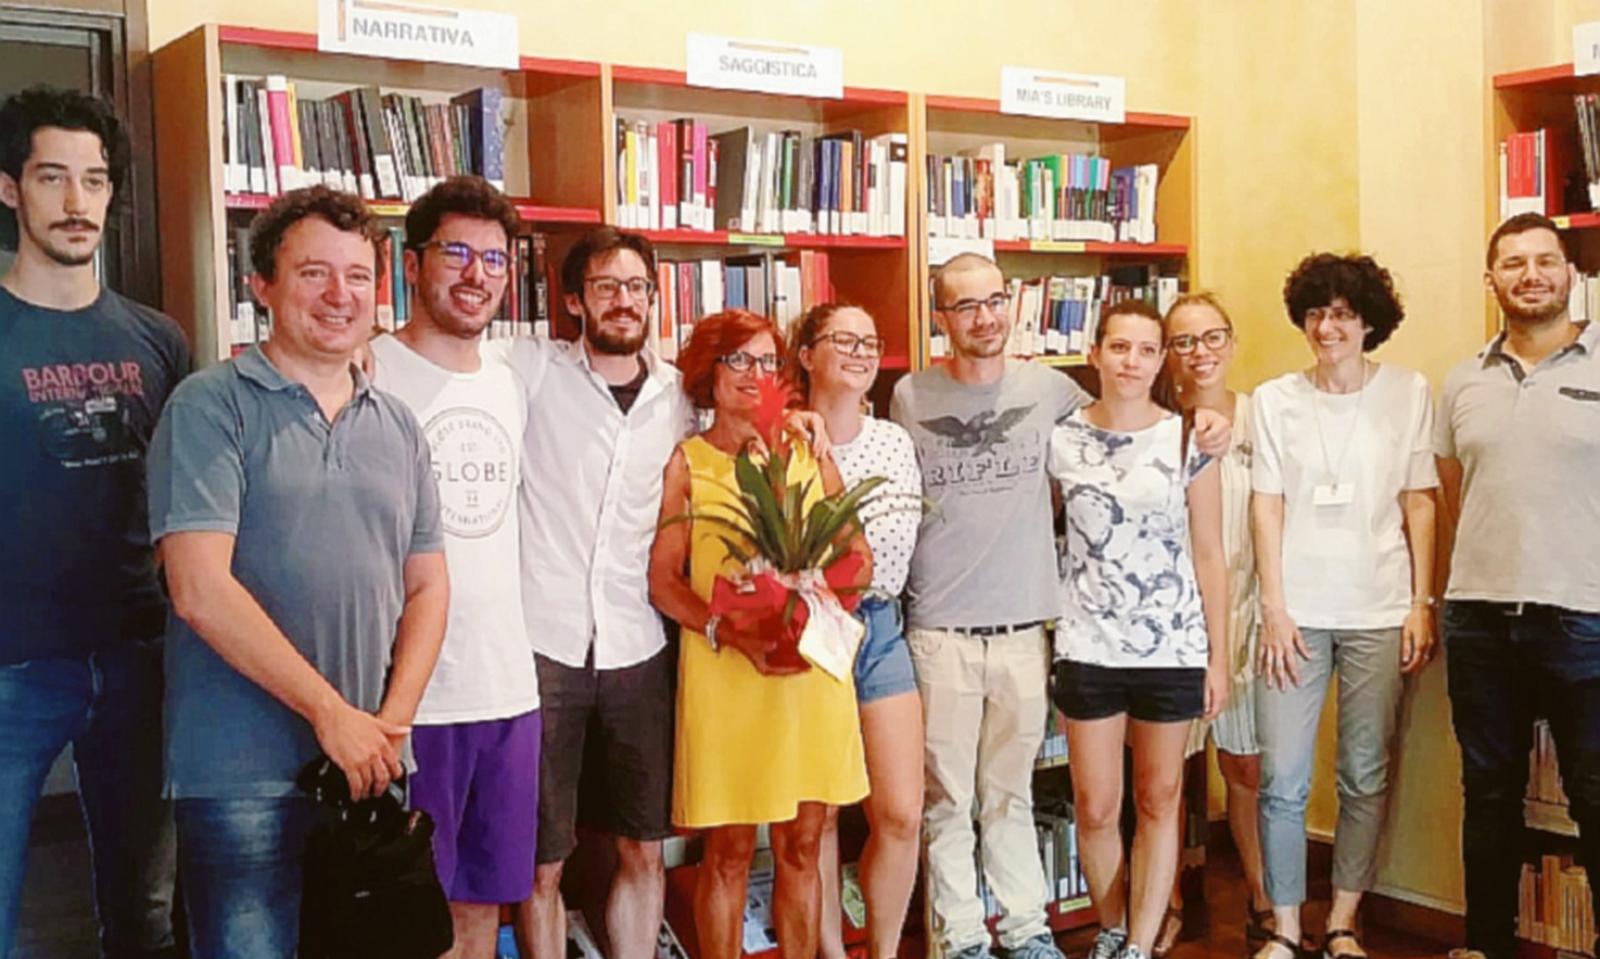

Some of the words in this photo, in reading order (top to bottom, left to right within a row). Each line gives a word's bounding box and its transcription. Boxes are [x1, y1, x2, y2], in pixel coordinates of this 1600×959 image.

[353, 17, 474, 47] NARRATIVA
[719, 55, 817, 78] SAGGISTICA
[1016, 88, 1053, 105] MIA'S
[1056, 92, 1112, 111] LIBRARY
